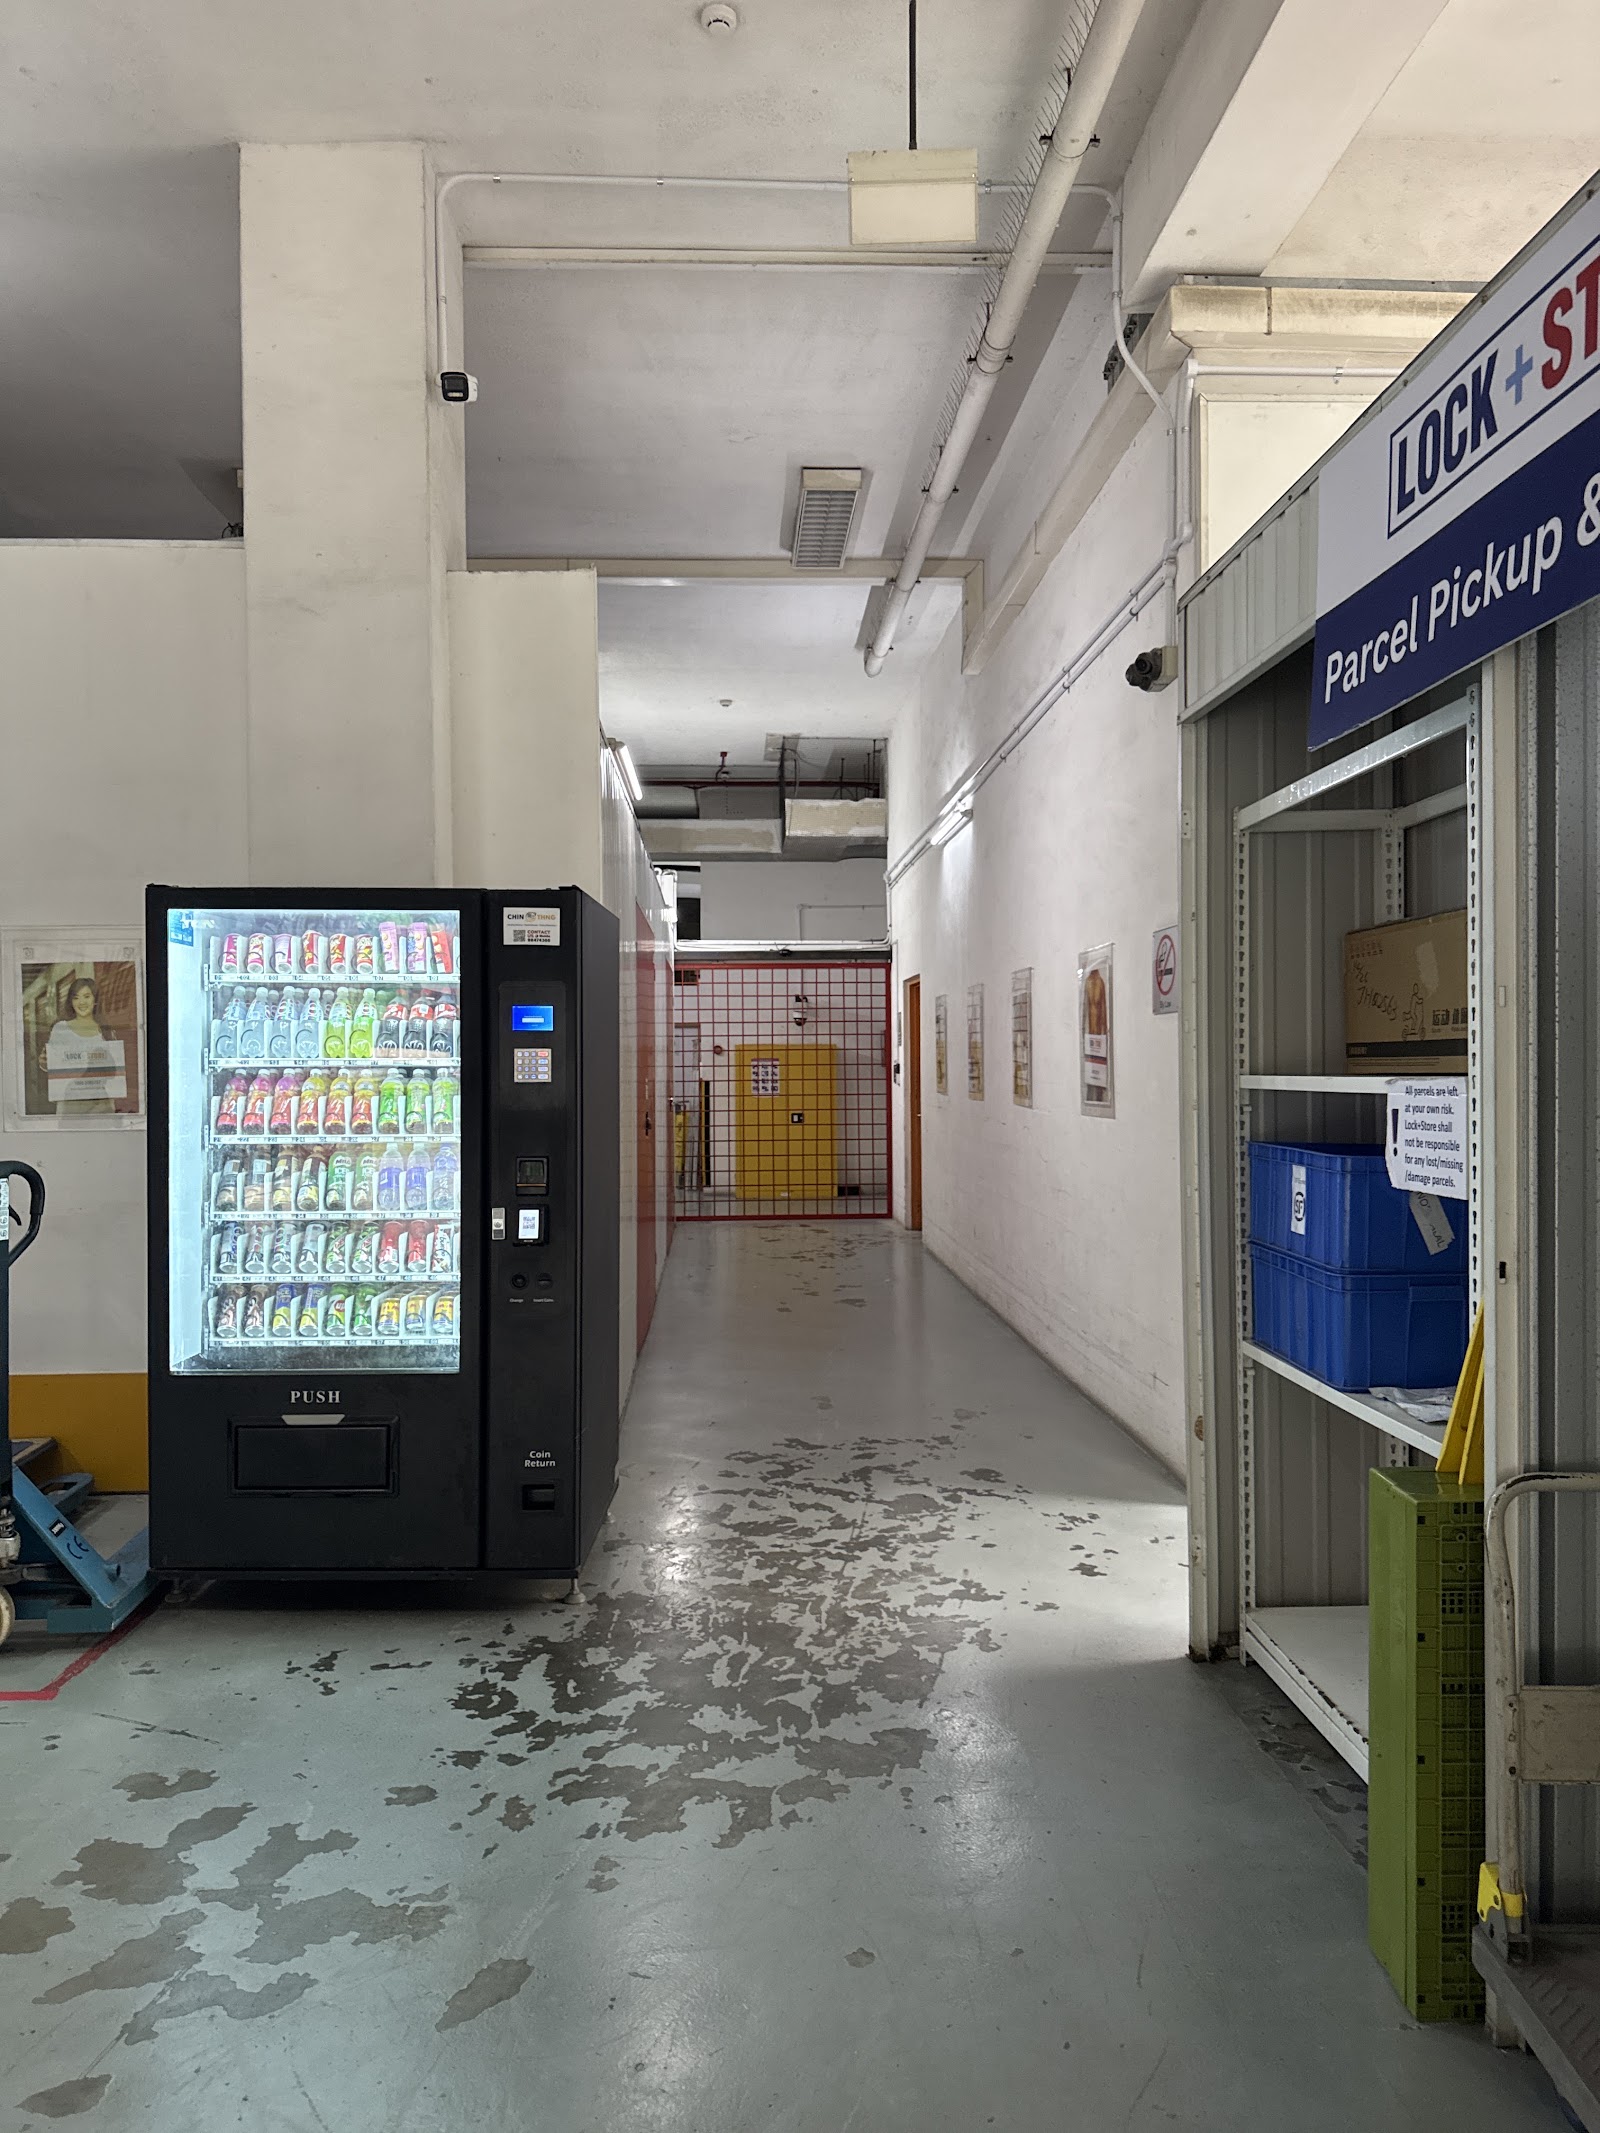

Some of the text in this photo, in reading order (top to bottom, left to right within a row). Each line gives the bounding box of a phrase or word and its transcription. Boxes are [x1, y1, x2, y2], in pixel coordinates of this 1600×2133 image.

[1325, 594, 1418, 704] Parcel
[1428, 516, 1563, 643] Pickup
[1413, 1085, 1435, 1098] parcels
[1436, 1088, 1446, 1097] are
[1447, 1085, 1459, 1097] left
[1404, 1103, 1455, 1115] at your own risk.
[1404, 1119, 1453, 1133] Lock+Store shall
[1404, 1137, 1460, 1152] not be responsible
[1404, 1153, 1464, 1173] for any lost/missing
[1404, 1169, 1456, 1187] /damage parcels.
[290, 1390, 341, 1404] PUSH
[529, 1450, 551, 1459] Coin
[524, 1459, 556, 1468] Return
